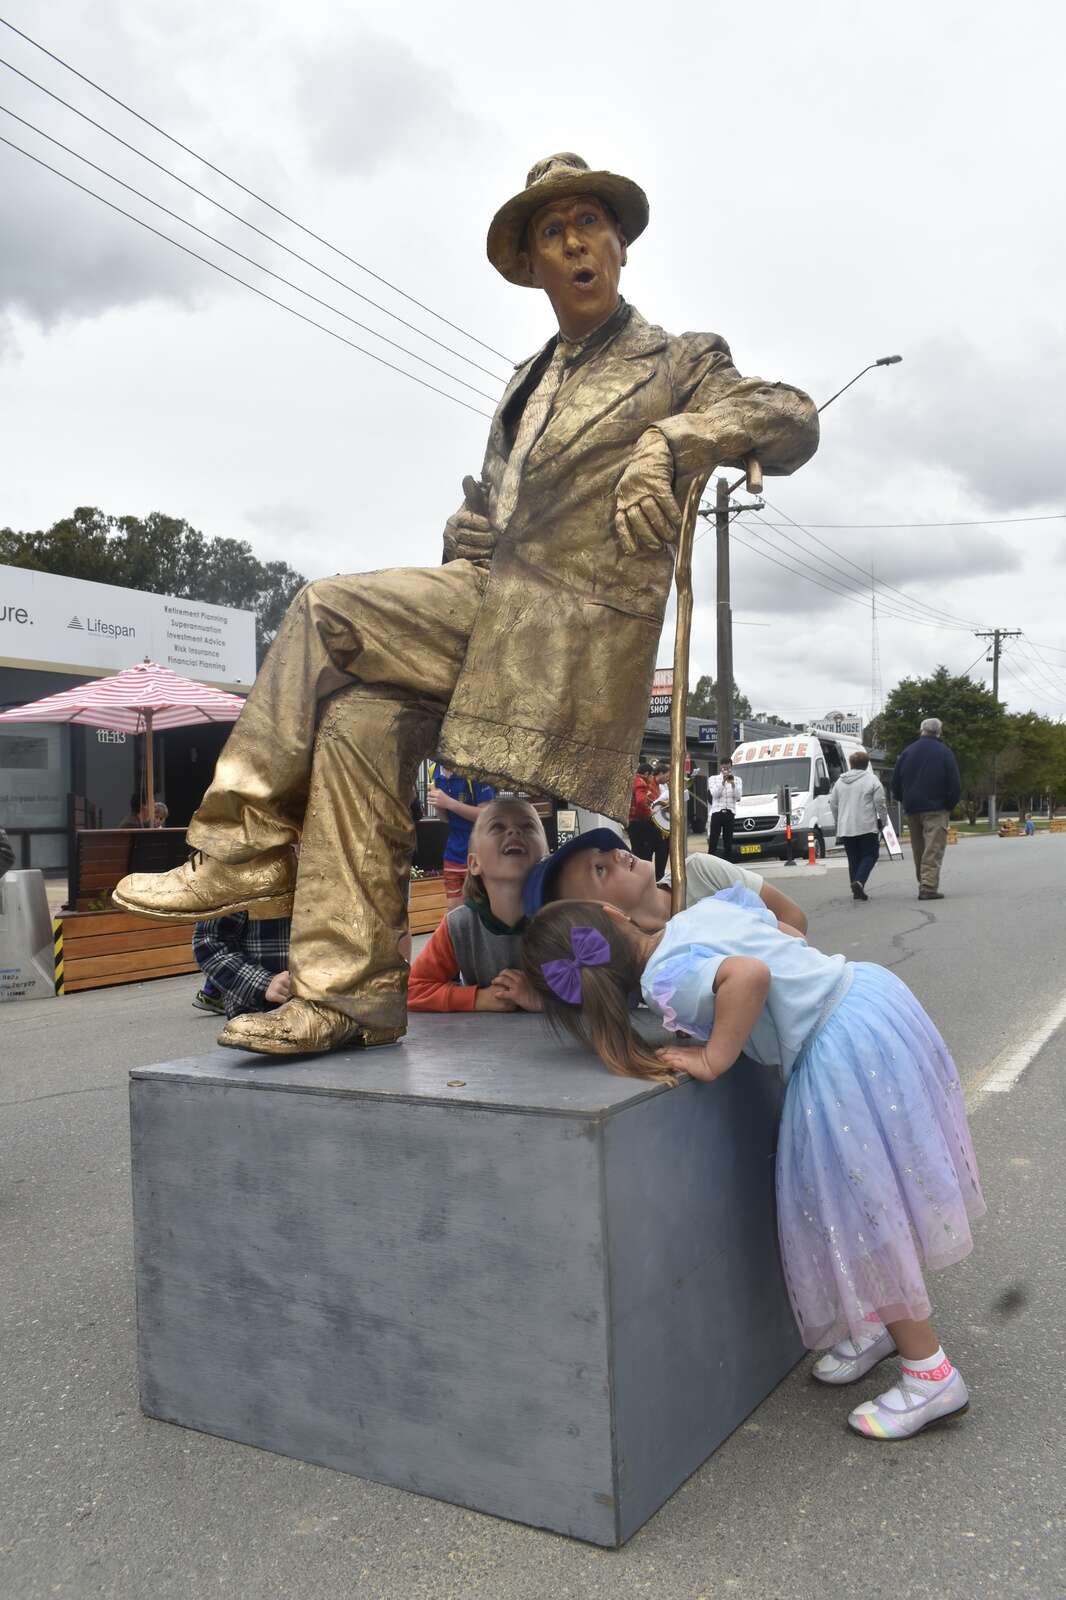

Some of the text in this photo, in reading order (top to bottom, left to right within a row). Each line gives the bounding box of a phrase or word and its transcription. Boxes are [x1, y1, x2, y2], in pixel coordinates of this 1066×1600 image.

[201, 611, 229, 625] Planning
[87, 618, 136, 639] Lifespan
[167, 632, 226, 647] Investment Advice
[174, 644, 220, 658] Risk Insurance
[167, 656, 226, 673] Financial Planning
[650, 705, 669, 714] SHOP
[835, 721, 860, 734] HOUSE
[95, 729, 127, 744] 111-113
[734, 743, 808, 764] COFFEE
